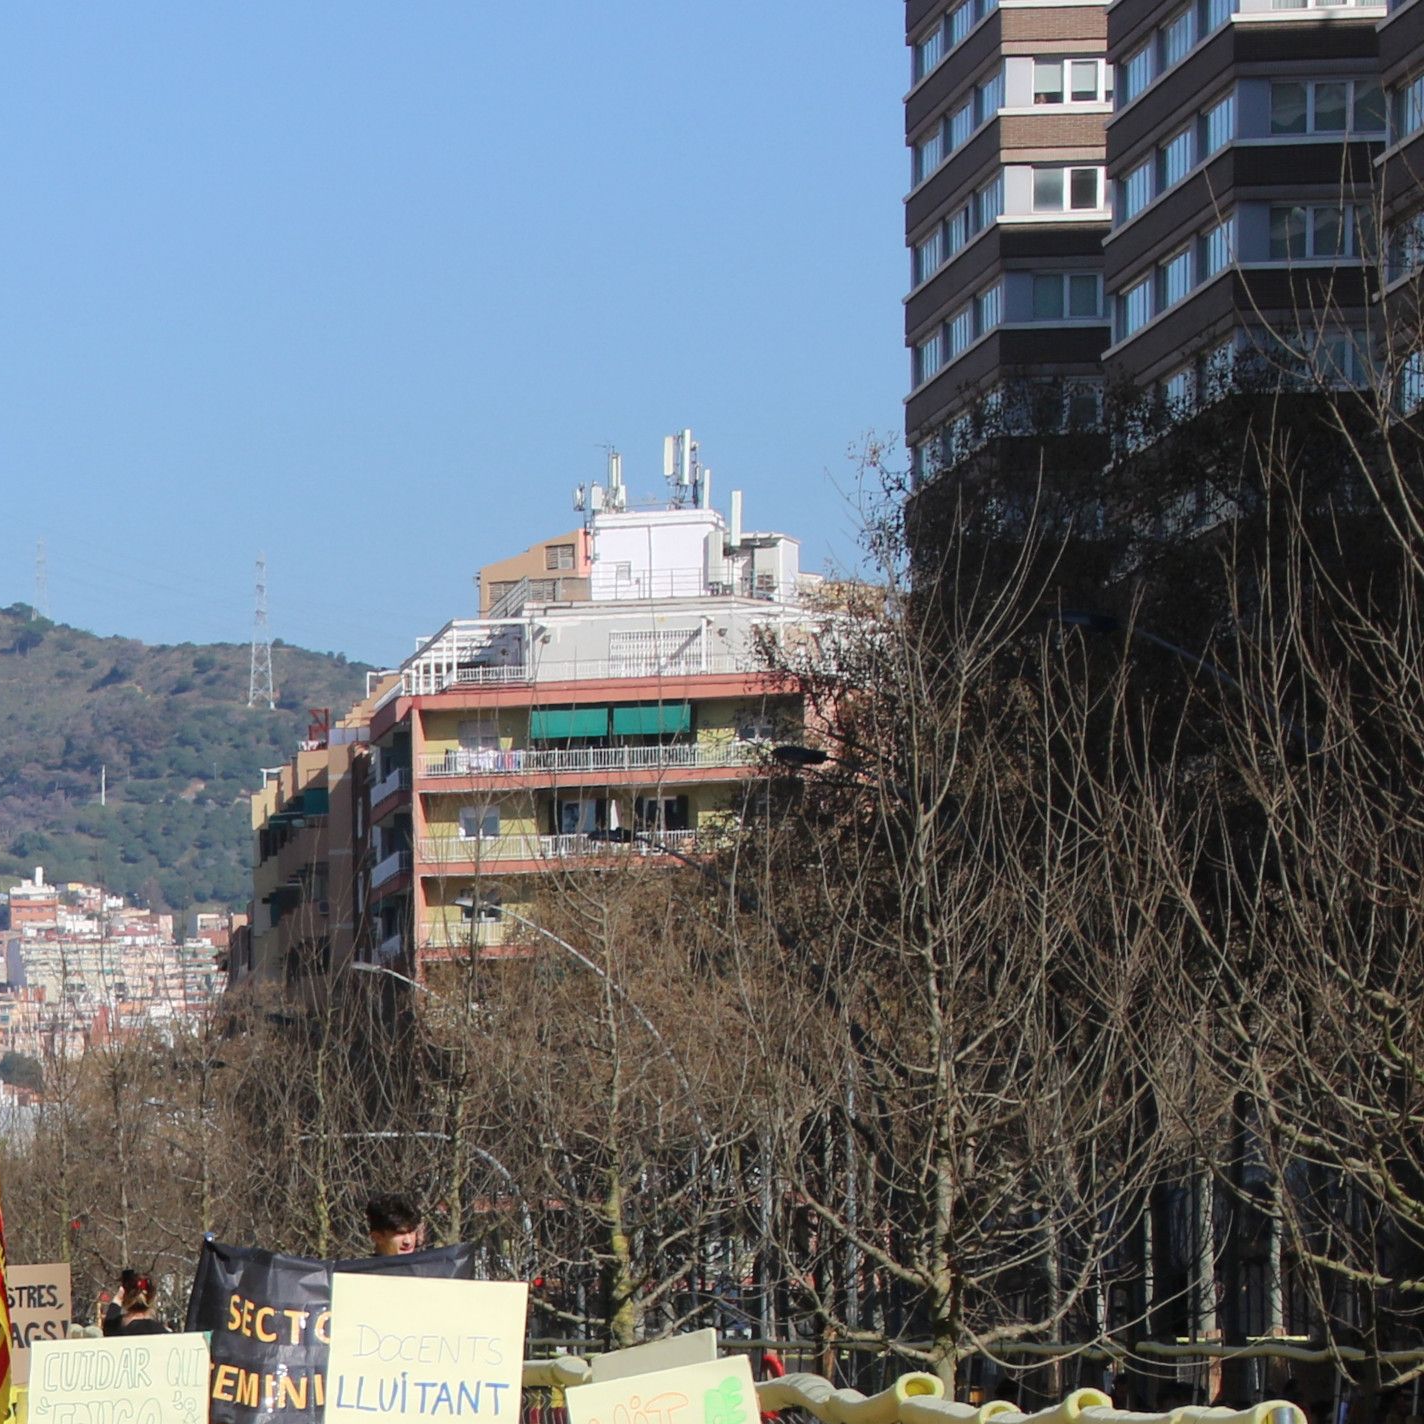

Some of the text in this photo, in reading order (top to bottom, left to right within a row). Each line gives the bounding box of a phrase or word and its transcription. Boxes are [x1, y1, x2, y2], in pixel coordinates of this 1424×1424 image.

[8, 1285, 65, 1308] STRES,
[12, 1320, 71, 1350] AGS!
[228, 1294, 332, 1345] SECTO
[352, 1323, 504, 1366] DOCENTS
[43, 1347, 204, 1393] CUIDAR QUI
[336, 1371, 510, 1417] LLUITANT
